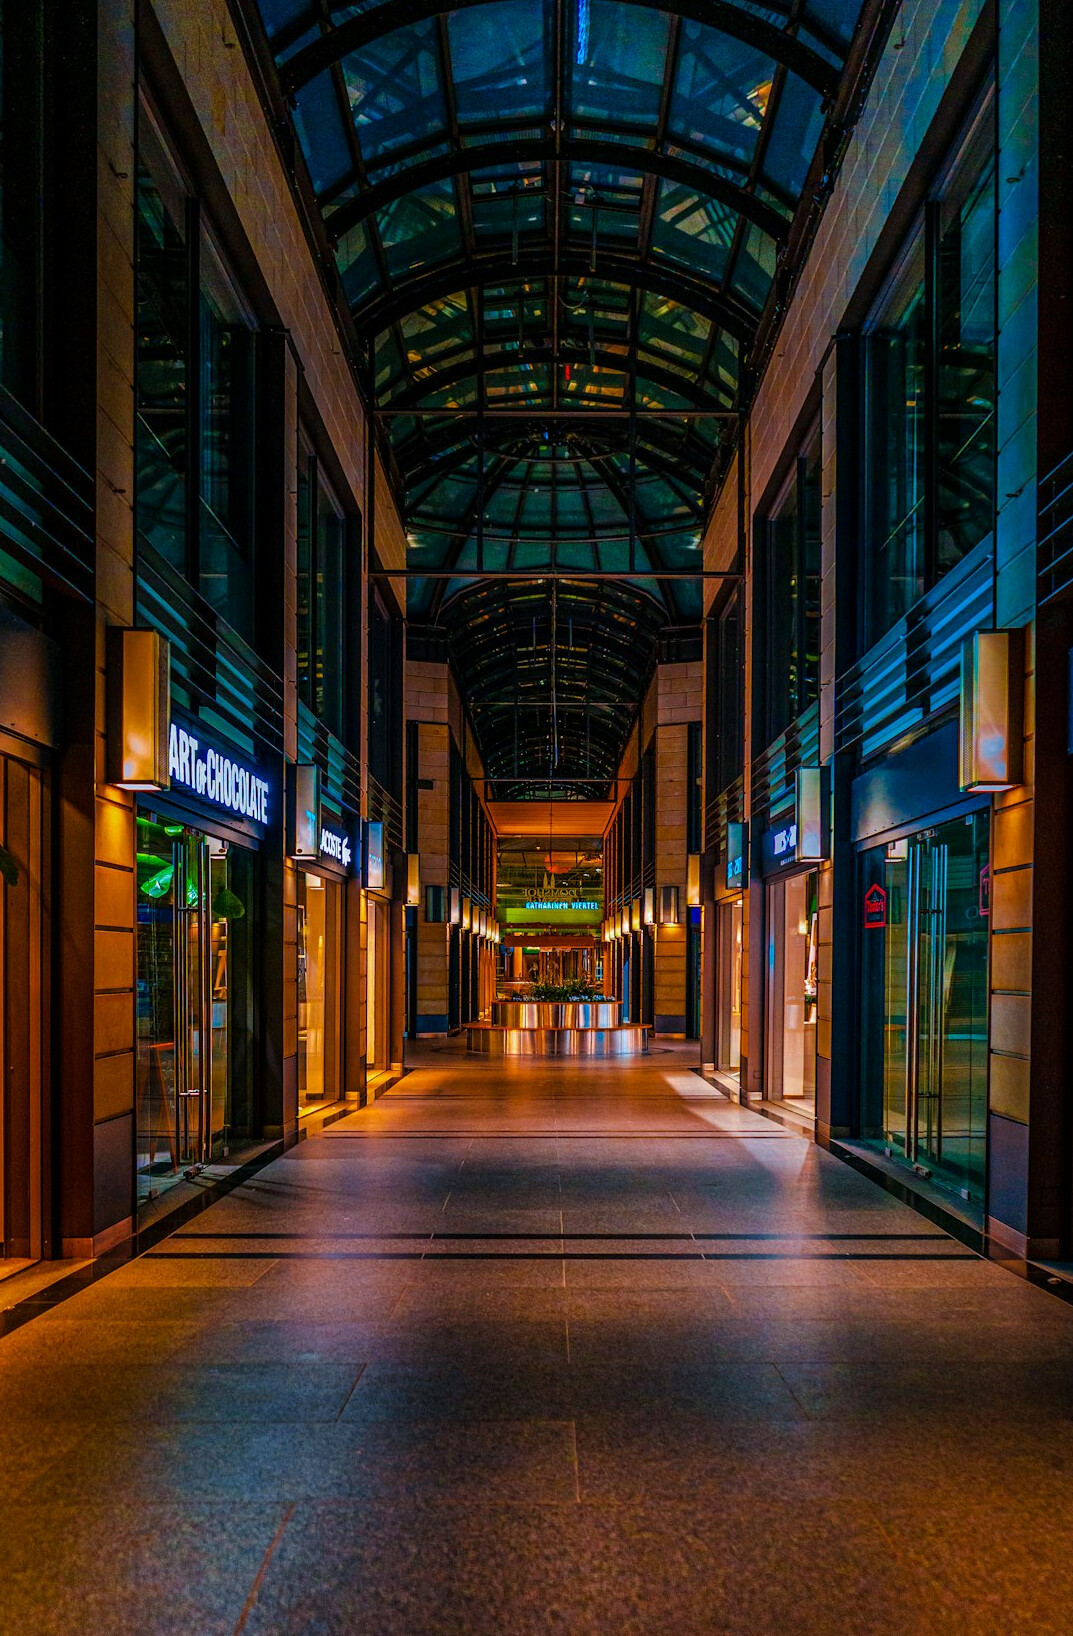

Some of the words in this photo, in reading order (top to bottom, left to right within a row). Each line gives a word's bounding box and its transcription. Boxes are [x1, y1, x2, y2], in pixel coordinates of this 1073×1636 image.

[169, 723, 198, 789] ART
[196, 759, 207, 795] OF
[207, 748, 269, 825] CHOCOLATE
[319, 828, 342, 860] ACOSTE
